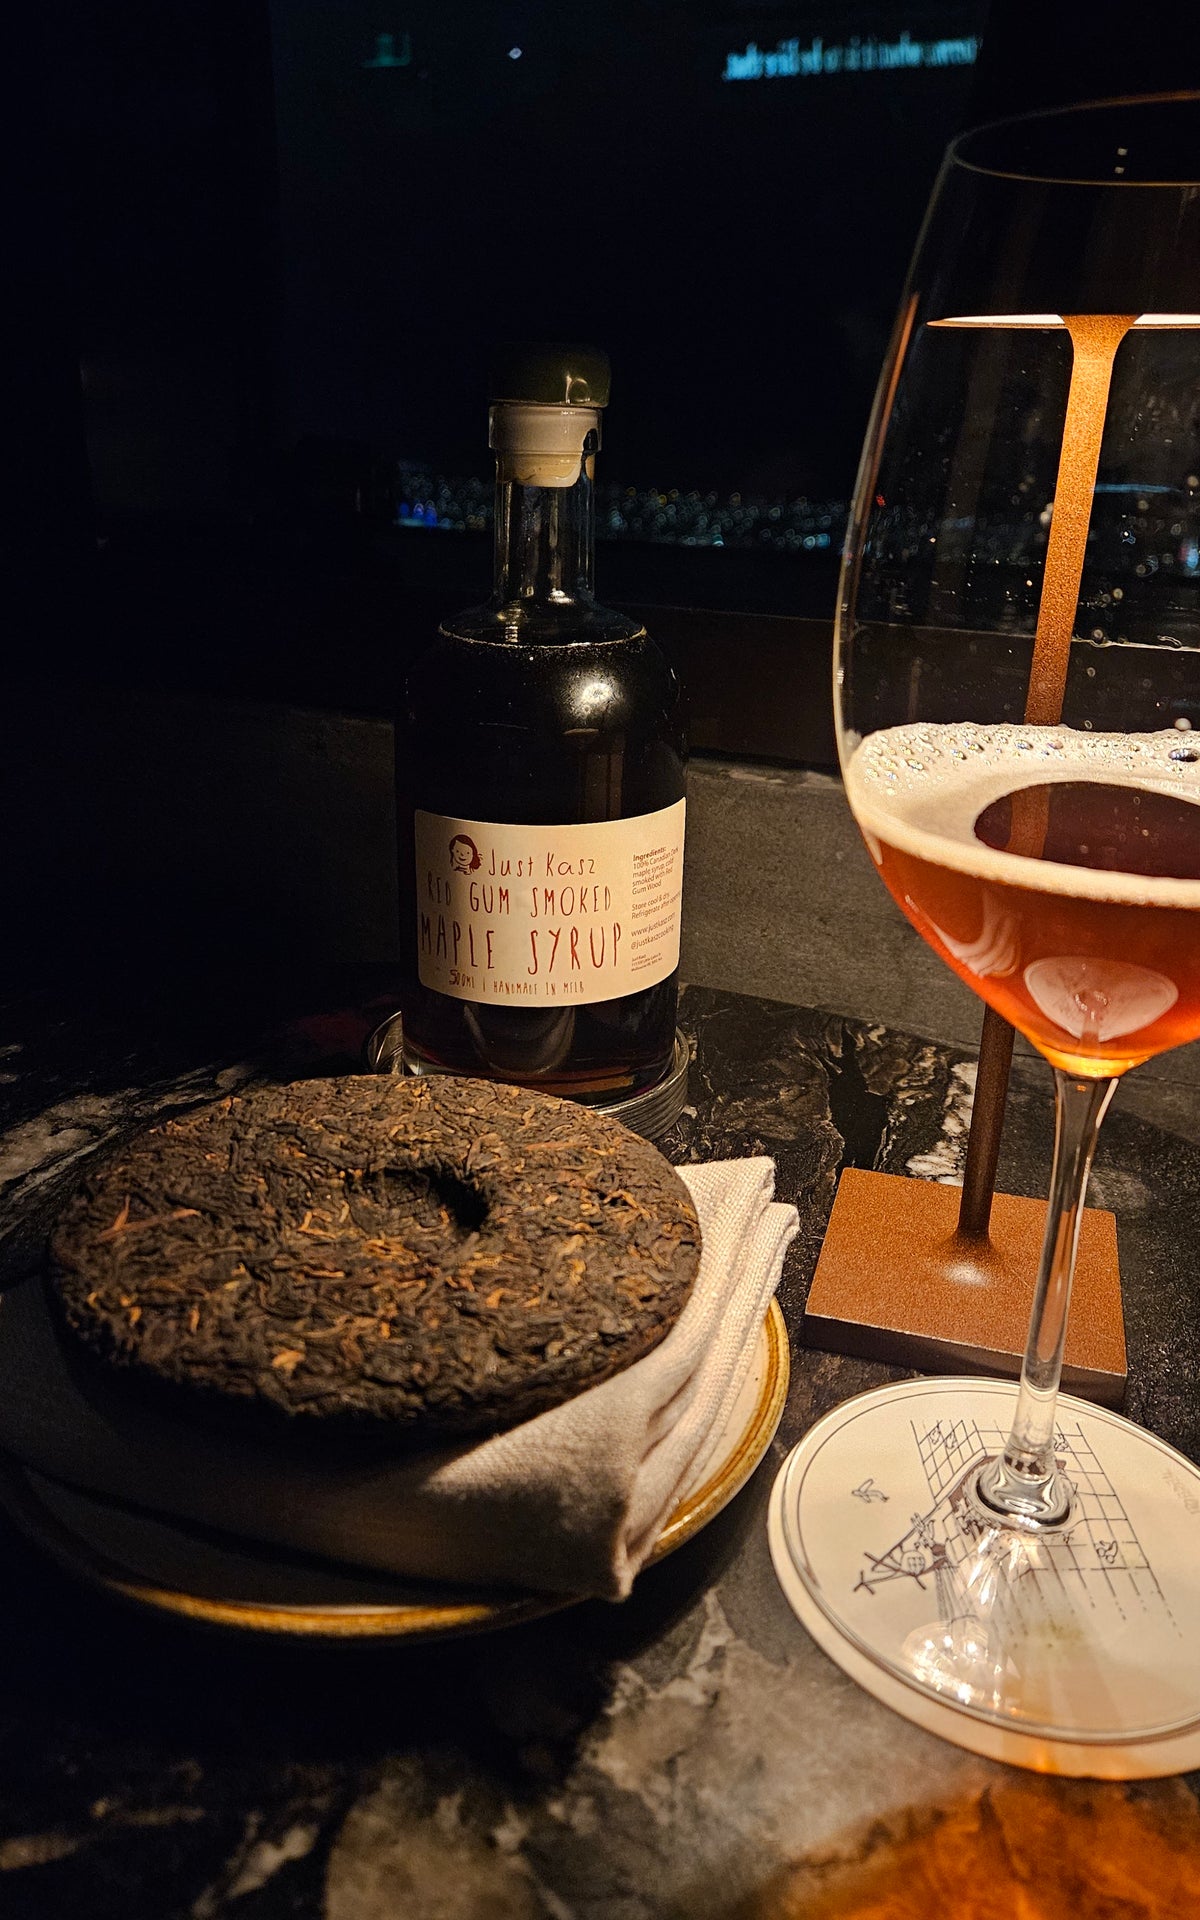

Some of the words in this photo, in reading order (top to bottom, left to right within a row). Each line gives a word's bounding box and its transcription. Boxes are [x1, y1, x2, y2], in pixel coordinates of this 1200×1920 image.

[633, 846, 667, 862] Ingredients:
[489, 849, 533, 876] Just
[546, 852, 596, 876] Kasz
[633, 860, 649, 870] 100%
[632, 874, 654, 887] smoked
[633, 868, 650, 879] maple
[428, 870, 452, 906] RED
[470, 881, 509, 915] GUM
[530, 885, 611, 918] SMOKED
[632, 887, 646, 895] Gum
[647, 879, 661, 890] Wood
[632, 902, 647, 911] Store
[648, 895, 658, 906] cool
[632, 905, 660, 919] Refrigerate
[421, 912, 494, 969] MAPLE
[528, 922, 621, 975] SYRUP
